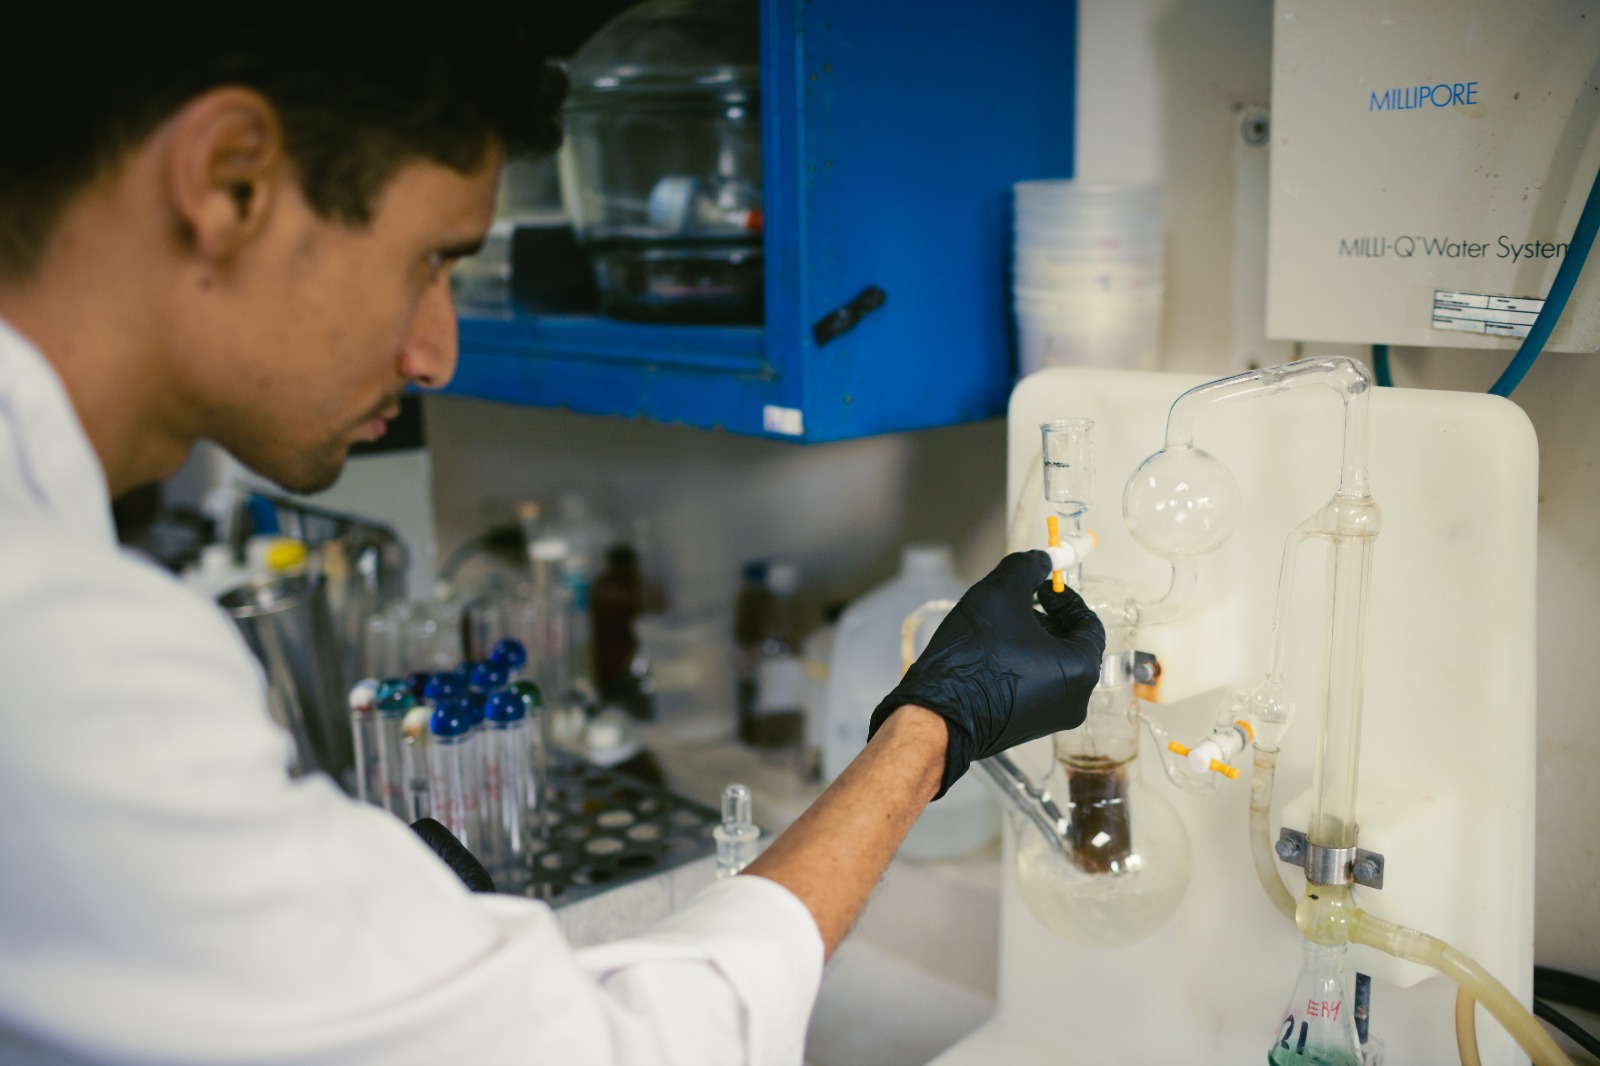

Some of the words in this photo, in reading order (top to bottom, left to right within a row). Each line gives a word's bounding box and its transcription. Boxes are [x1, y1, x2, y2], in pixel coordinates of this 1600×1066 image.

[1369, 82, 1478, 112] MILLIPORE
[1423, 236, 1490, 258] Water
[1280, 1014, 1309, 1056] 21
